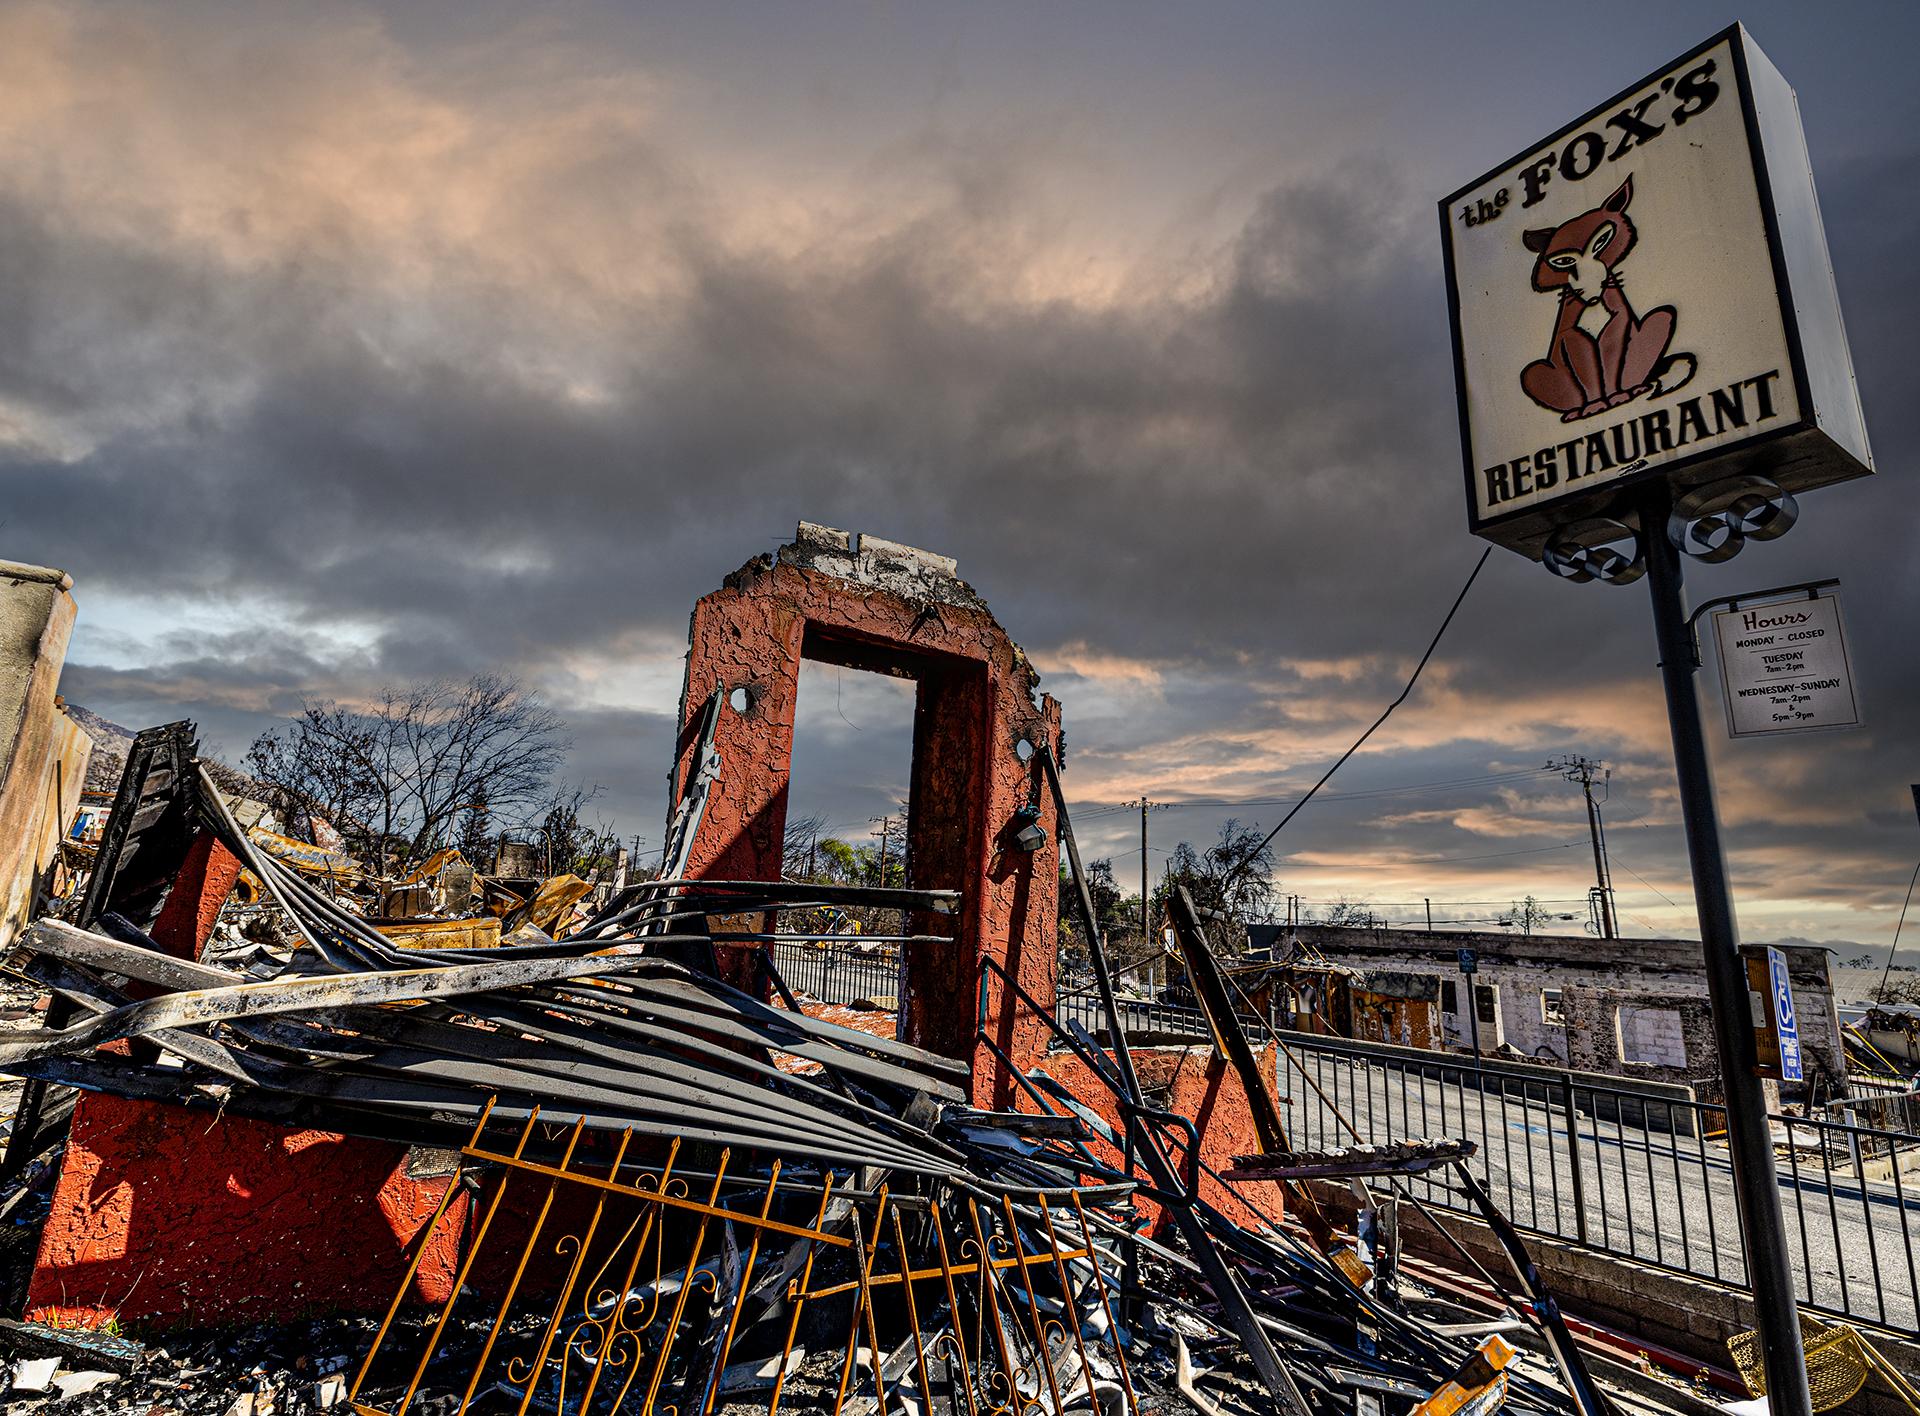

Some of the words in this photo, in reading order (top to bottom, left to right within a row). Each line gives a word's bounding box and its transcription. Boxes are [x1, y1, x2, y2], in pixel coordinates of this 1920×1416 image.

[1458, 188, 1509, 228] the
[1517, 58, 1720, 209] FOX'S
[1483, 369, 1779, 506] RESTAURANT
[1743, 611, 1813, 631] Hours
[1736, 635, 1775, 649] MONDAY
[1787, 629, 1825, 642] CLOSED
[1762, 651, 1804, 664] TUESDAY
[1765, 662, 1805, 673] 7am-2pm
[1738, 678, 1840, 698] WEDNESDAY-SUNDAY
[1769, 694, 1811, 705] 7am-2pm
[1772, 711, 1815, 722] 5pm-9pm
